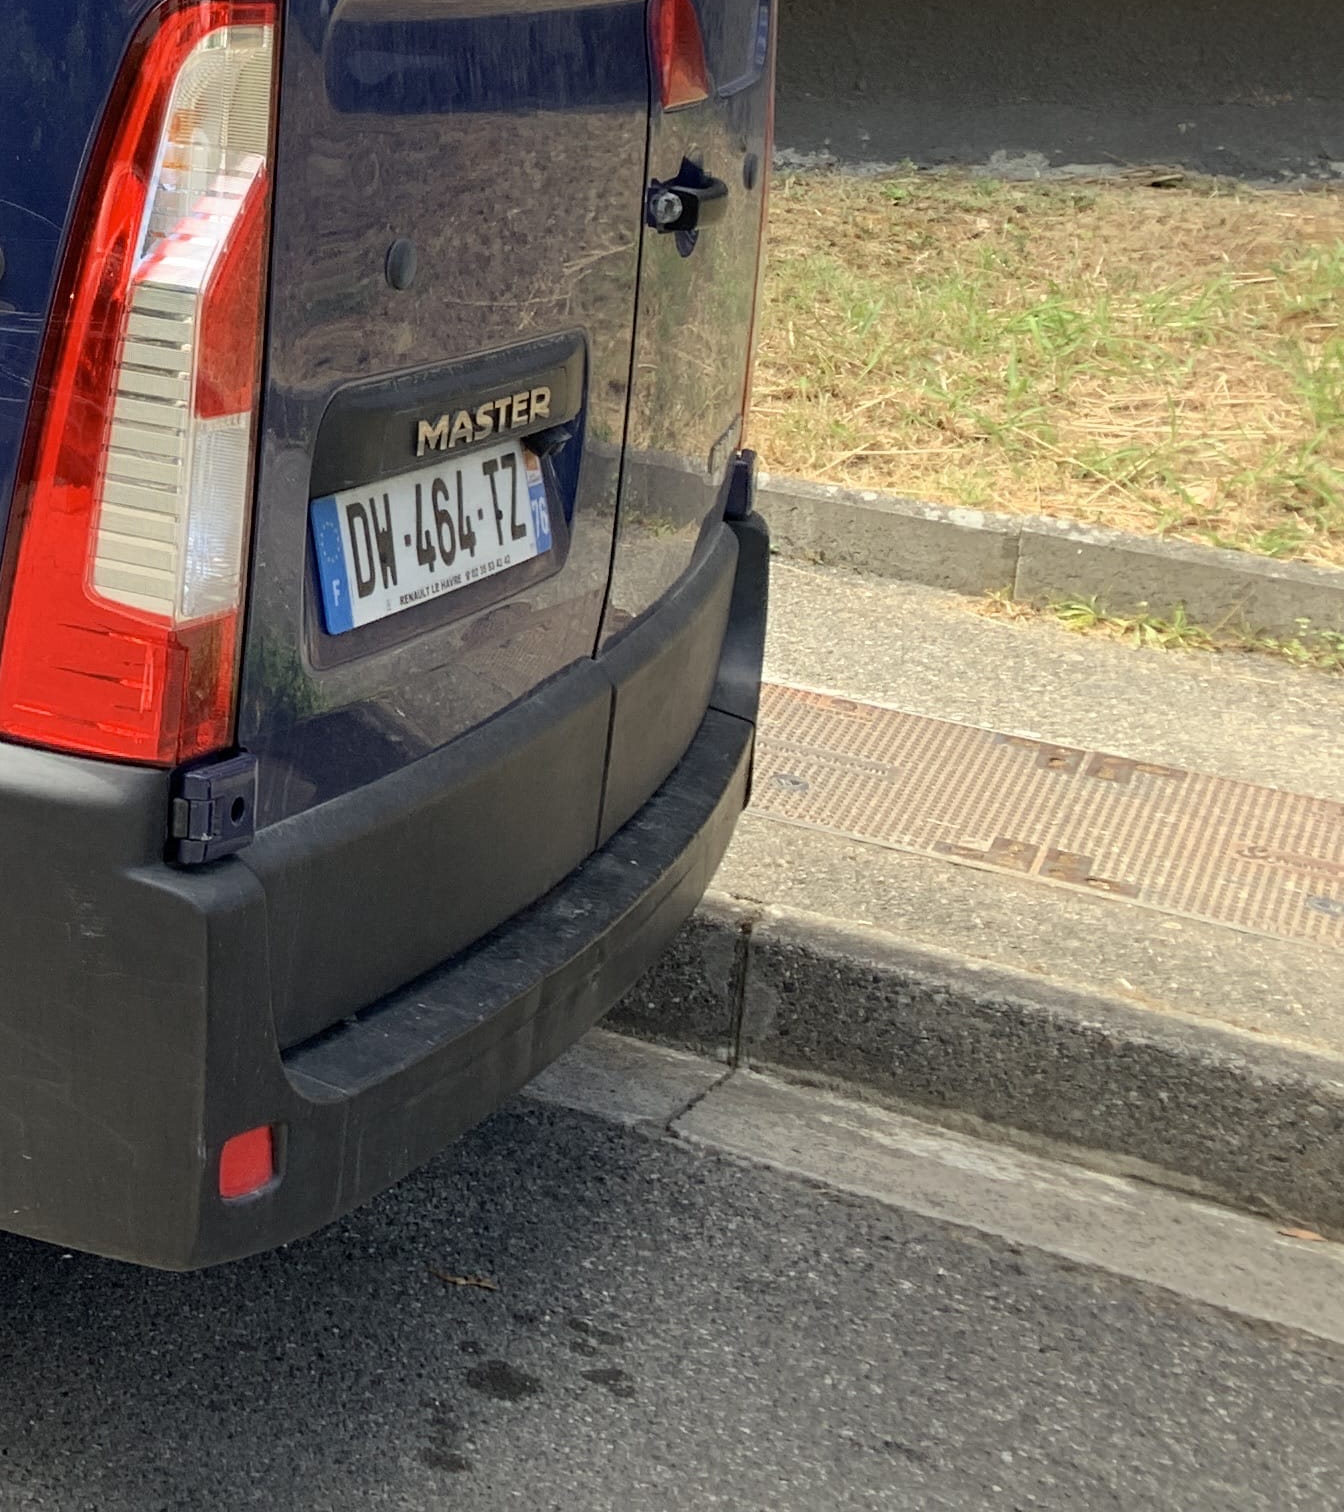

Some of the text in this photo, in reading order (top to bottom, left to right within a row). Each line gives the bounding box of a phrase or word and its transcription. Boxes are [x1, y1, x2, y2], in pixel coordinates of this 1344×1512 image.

[416, 387, 551, 456] MASTER
[332, 578, 341, 607] F
[531, 495, 551, 539] 76
